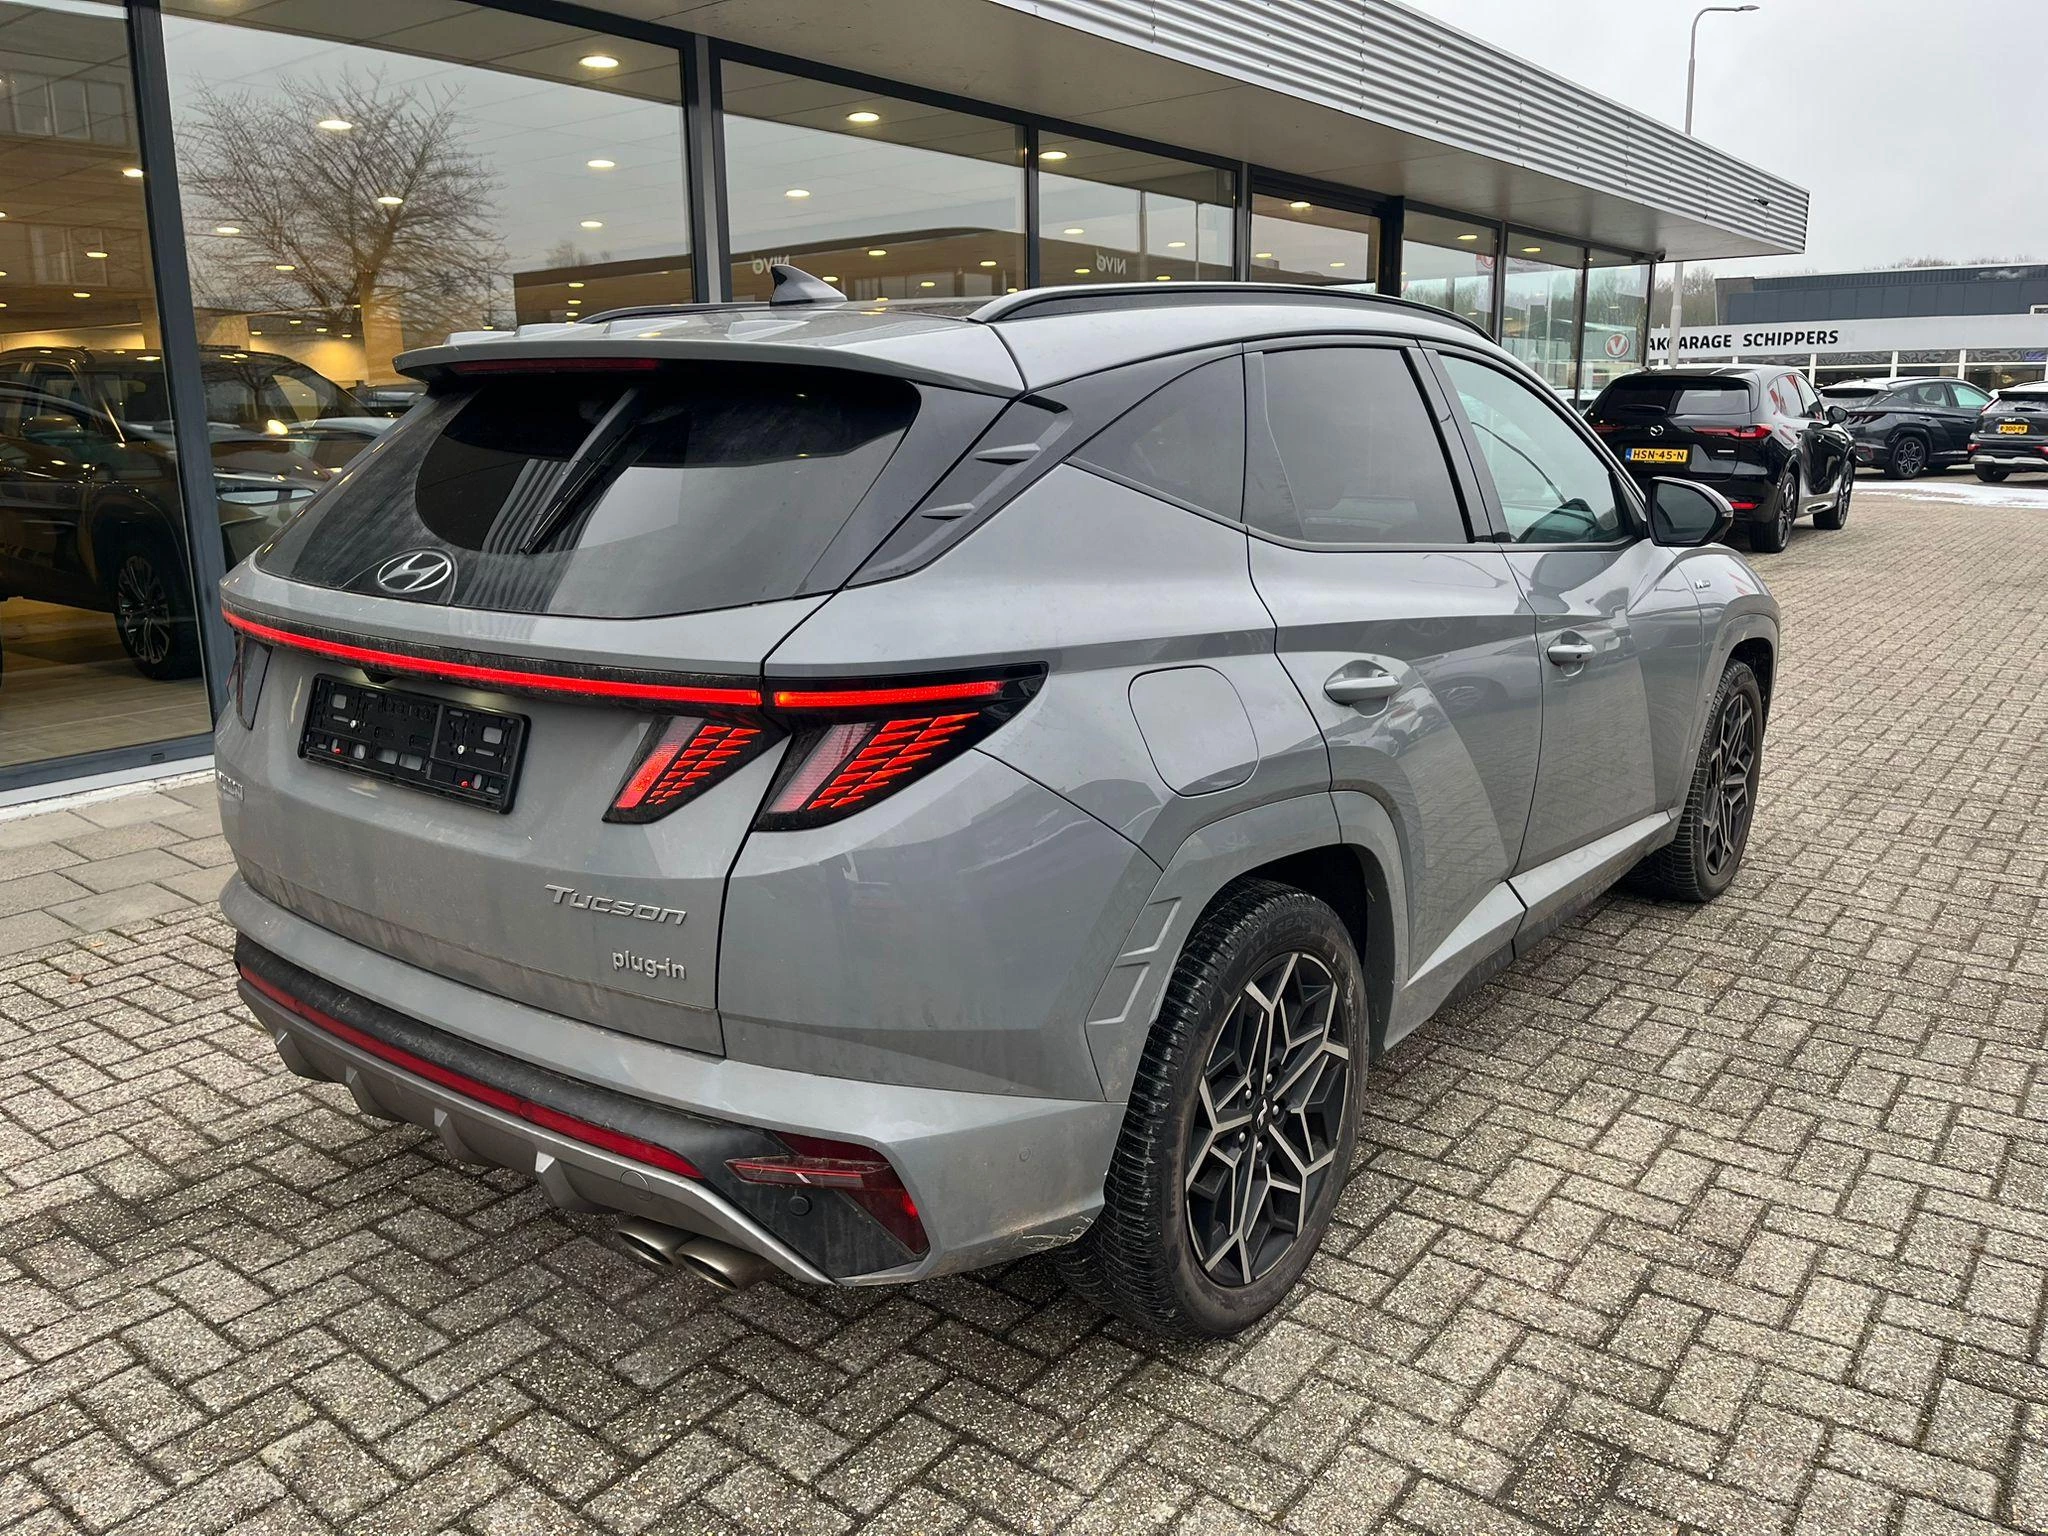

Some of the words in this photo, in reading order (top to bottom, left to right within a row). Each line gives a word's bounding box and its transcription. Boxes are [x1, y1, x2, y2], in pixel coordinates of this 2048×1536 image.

[1742, 330, 1839, 348] SCHIPPERS
[1632, 449, 1685, 460] HSN-45-N
[612, 950, 686, 979] plug-in
